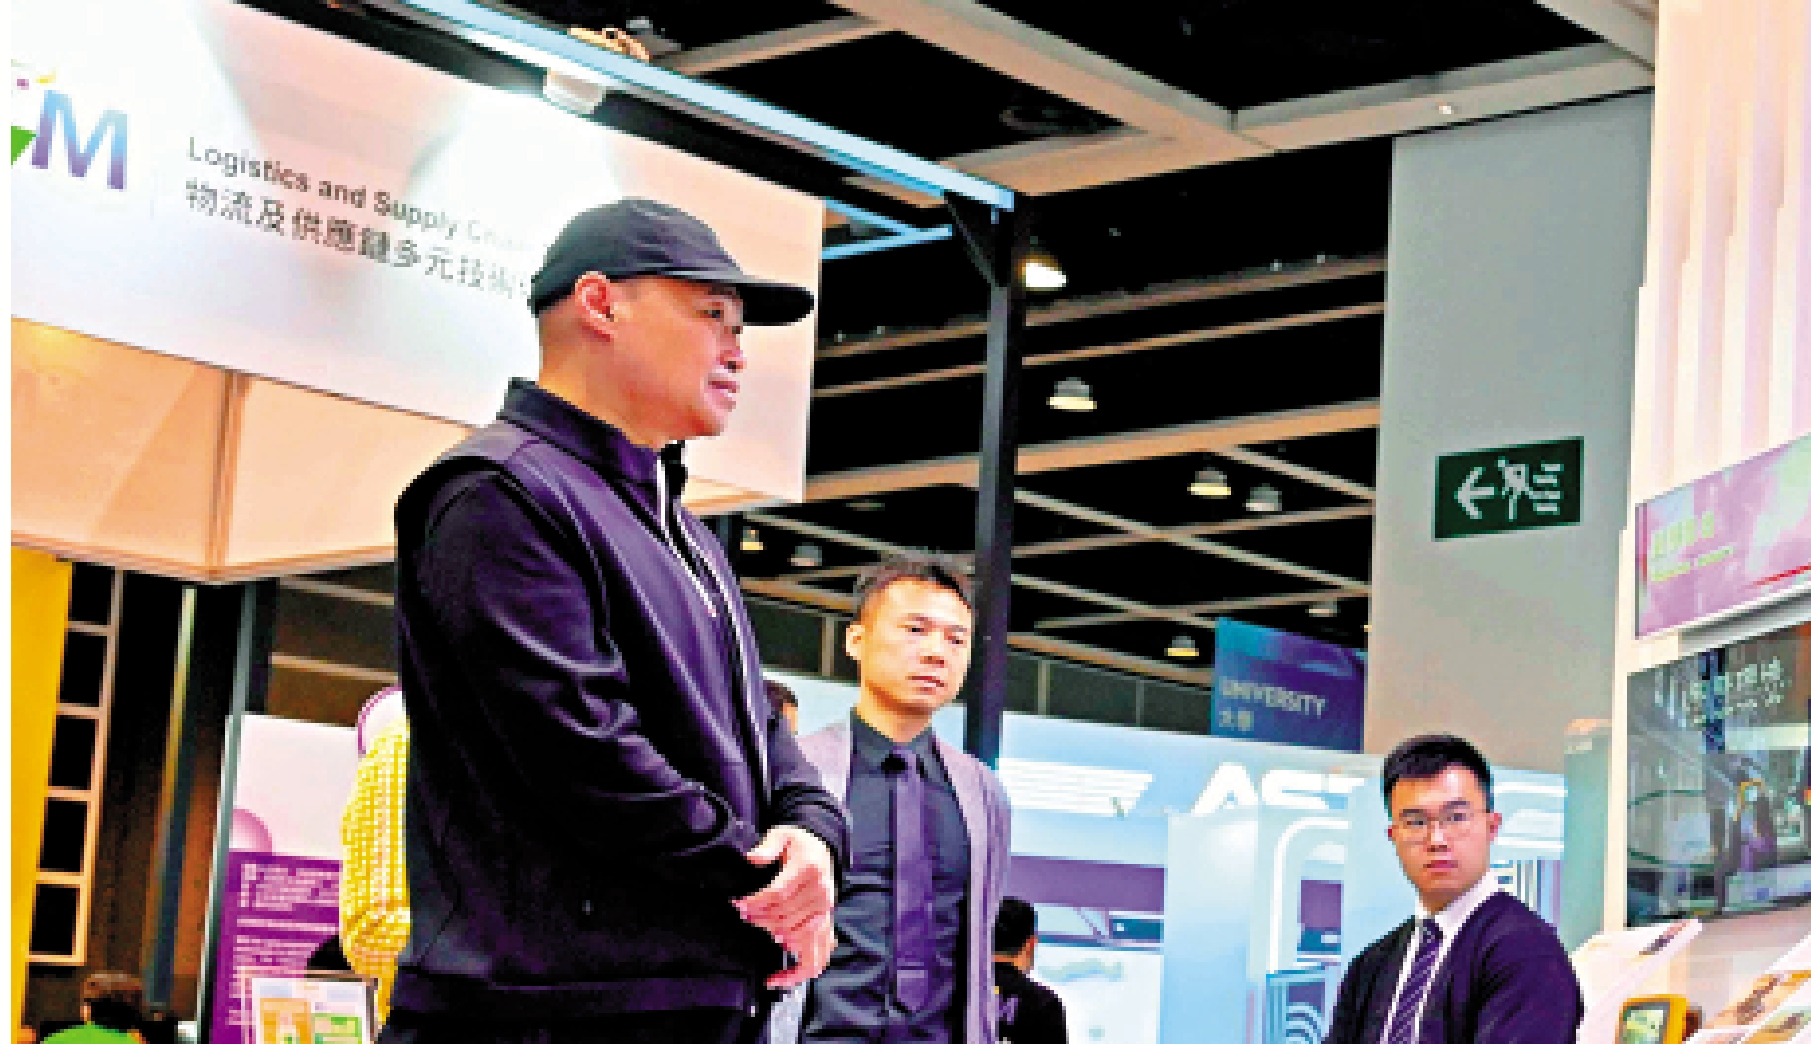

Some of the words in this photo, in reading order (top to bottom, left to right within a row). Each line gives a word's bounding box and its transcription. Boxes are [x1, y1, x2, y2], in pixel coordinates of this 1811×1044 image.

[189, 136, 310, 192] Logistics
[318, 180, 367, 208] and
[374, 191, 457, 239] Supply
[1220, 676, 1328, 719] UNIVERSITY
